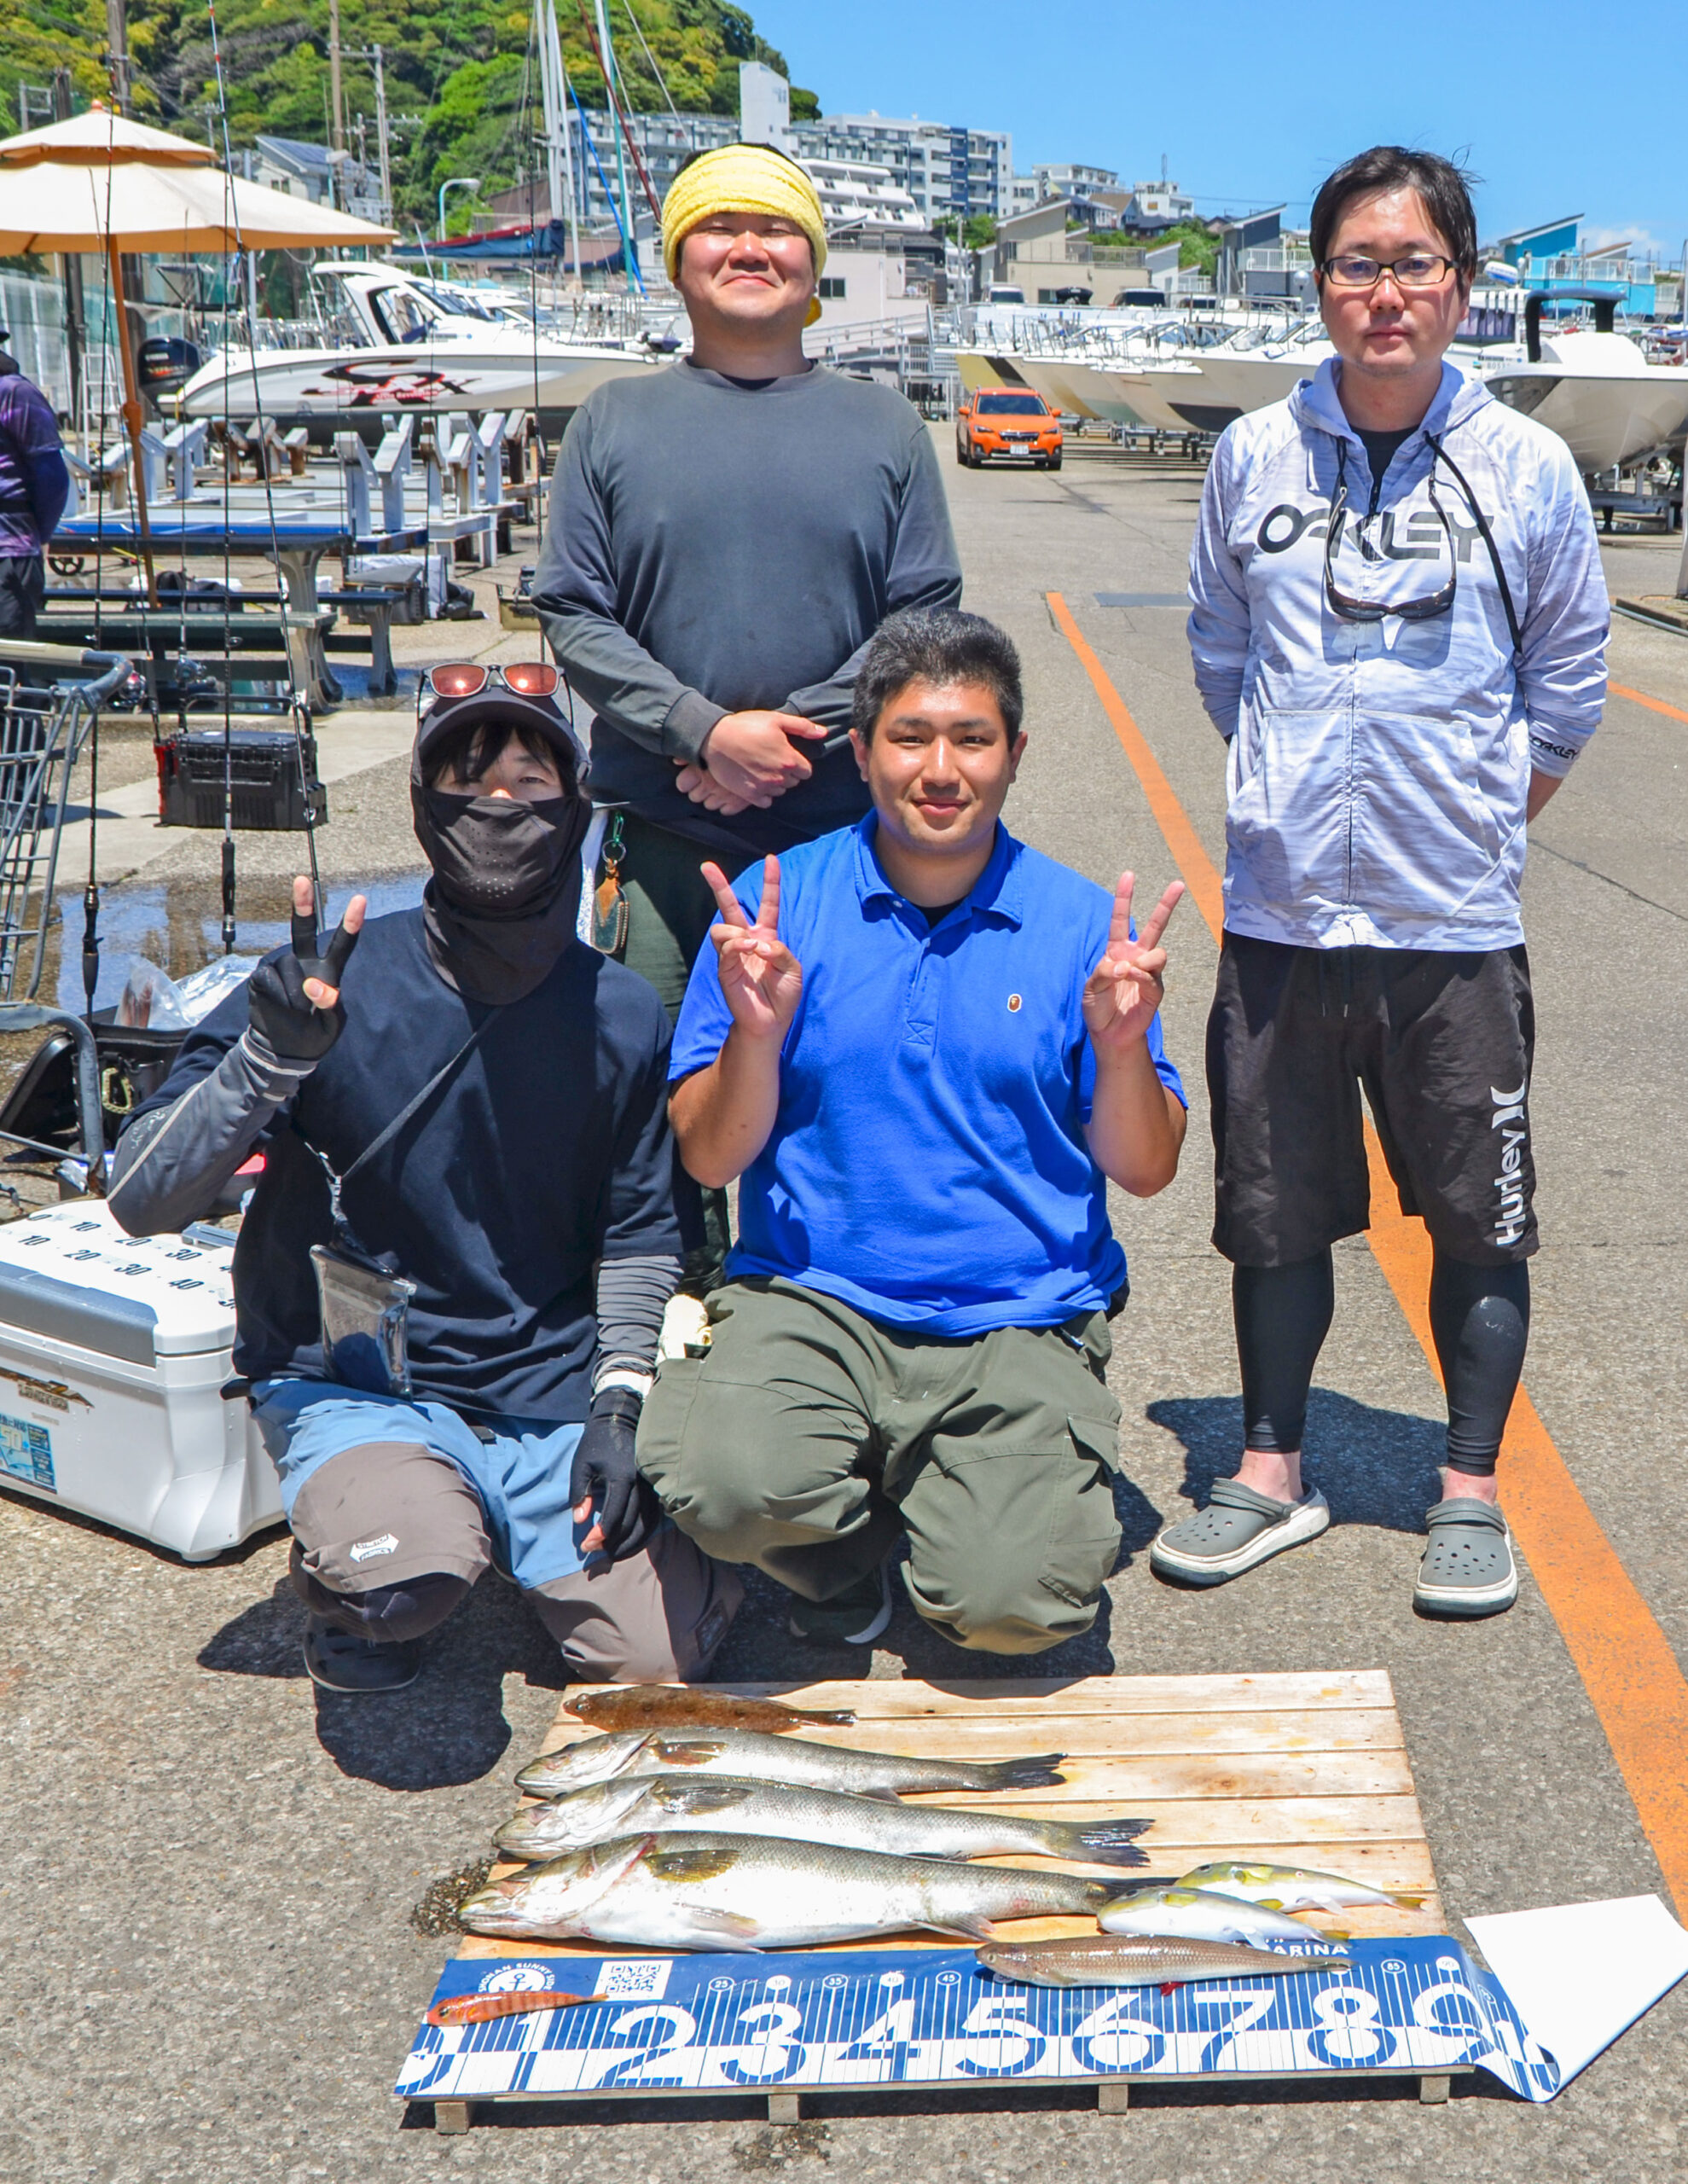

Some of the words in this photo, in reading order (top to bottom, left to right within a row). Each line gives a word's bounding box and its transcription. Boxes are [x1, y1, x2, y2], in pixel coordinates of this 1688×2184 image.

[1257, 504, 1494, 563] OAKLEY
[1532, 737, 1579, 760] OAKLEY
[1494, 1129, 1526, 1246] Hurley
[69, 1222, 102, 1231] 10
[165, 1248, 203, 1261] 30
[18, 1235, 51, 1246] 10
[62, 1249, 102, 1261] 20
[113, 1263, 153, 1275] 30
[168, 1279, 205, 1290] 40
[1273, 1943, 1349, 1958] ARINA
[478, 1964, 512, 1993] SHONAN
[515, 1962, 553, 1975] SUNNY
[714, 1979, 729, 1989] 25
[827, 1977, 843, 1985] 35
[942, 1973, 956, 1983] 45
[1386, 1961, 1401, 1971] 85
[595, 2005, 697, 2088] 2
[720, 2002, 807, 2084] 3
[835, 1999, 921, 2082] 4
[954, 1996, 1047, 2077] 5
[1071, 1992, 1167, 2073] 6
[1193, 1989, 1275, 2071] 7
[1306, 1986, 1398, 2068] 8
[1412, 1982, 1494, 2065] 9
